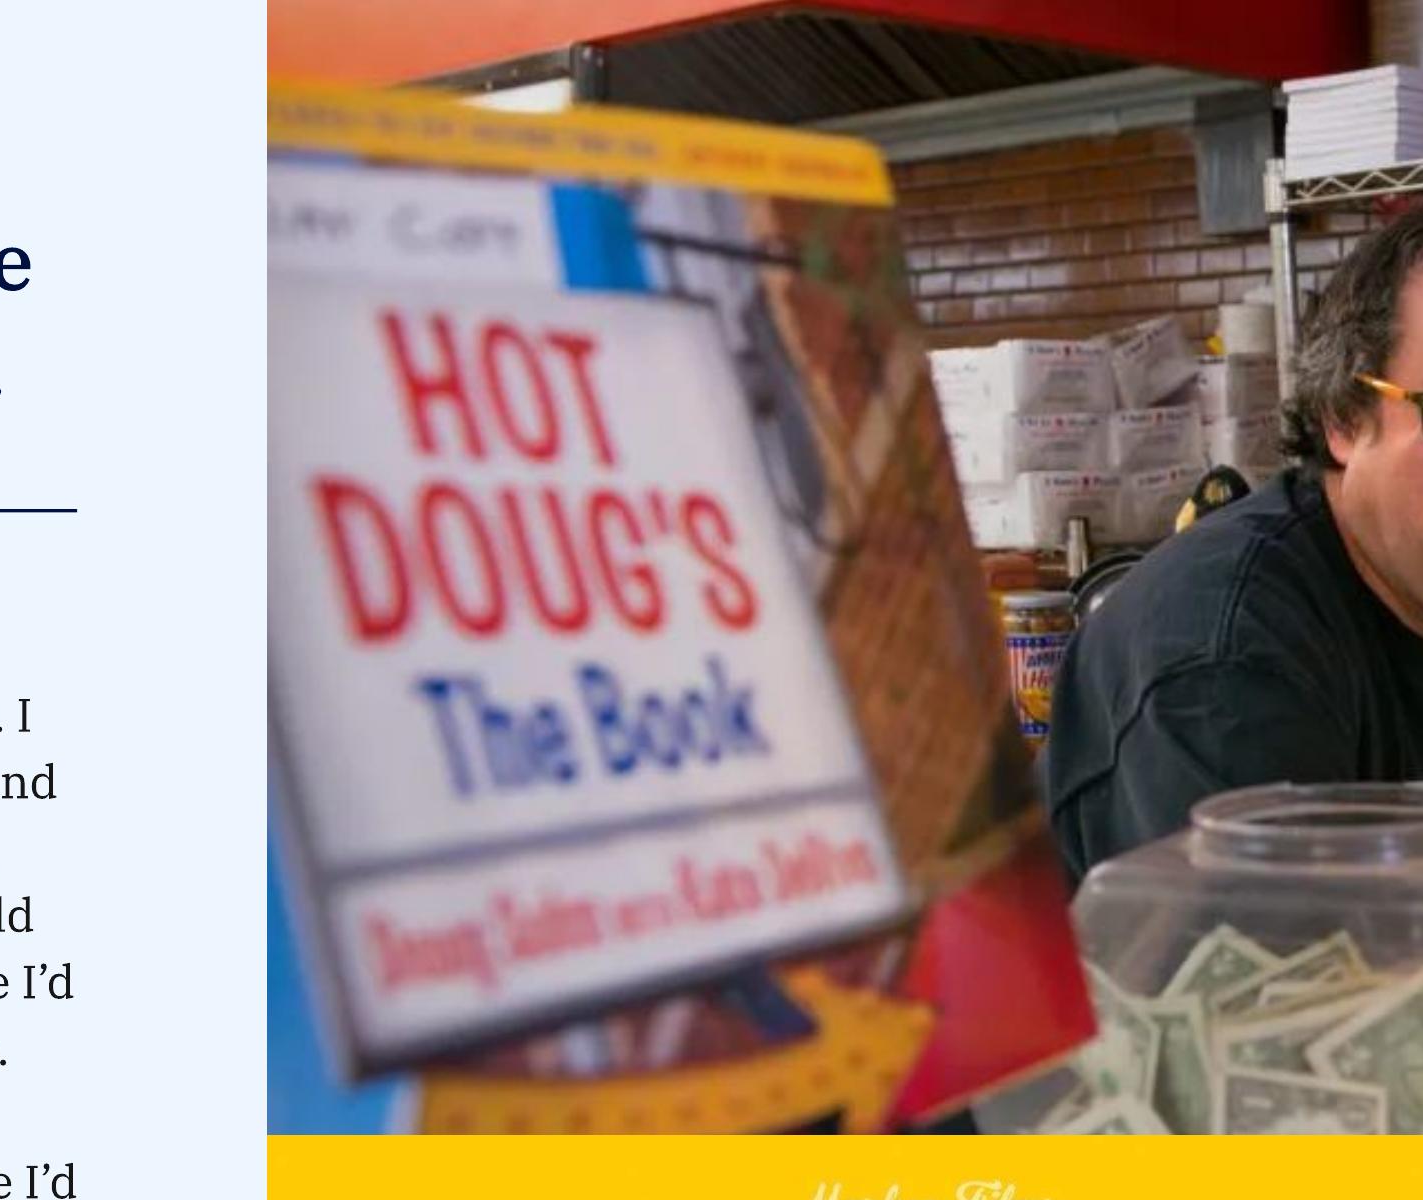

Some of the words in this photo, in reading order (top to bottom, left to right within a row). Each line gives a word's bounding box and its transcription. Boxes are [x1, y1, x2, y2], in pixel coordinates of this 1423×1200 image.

[380, 306, 617, 469] HOT
[313, 471, 758, 645] DOUG'S
[413, 676, 581, 795] The
[577, 652, 770, 774] Book
